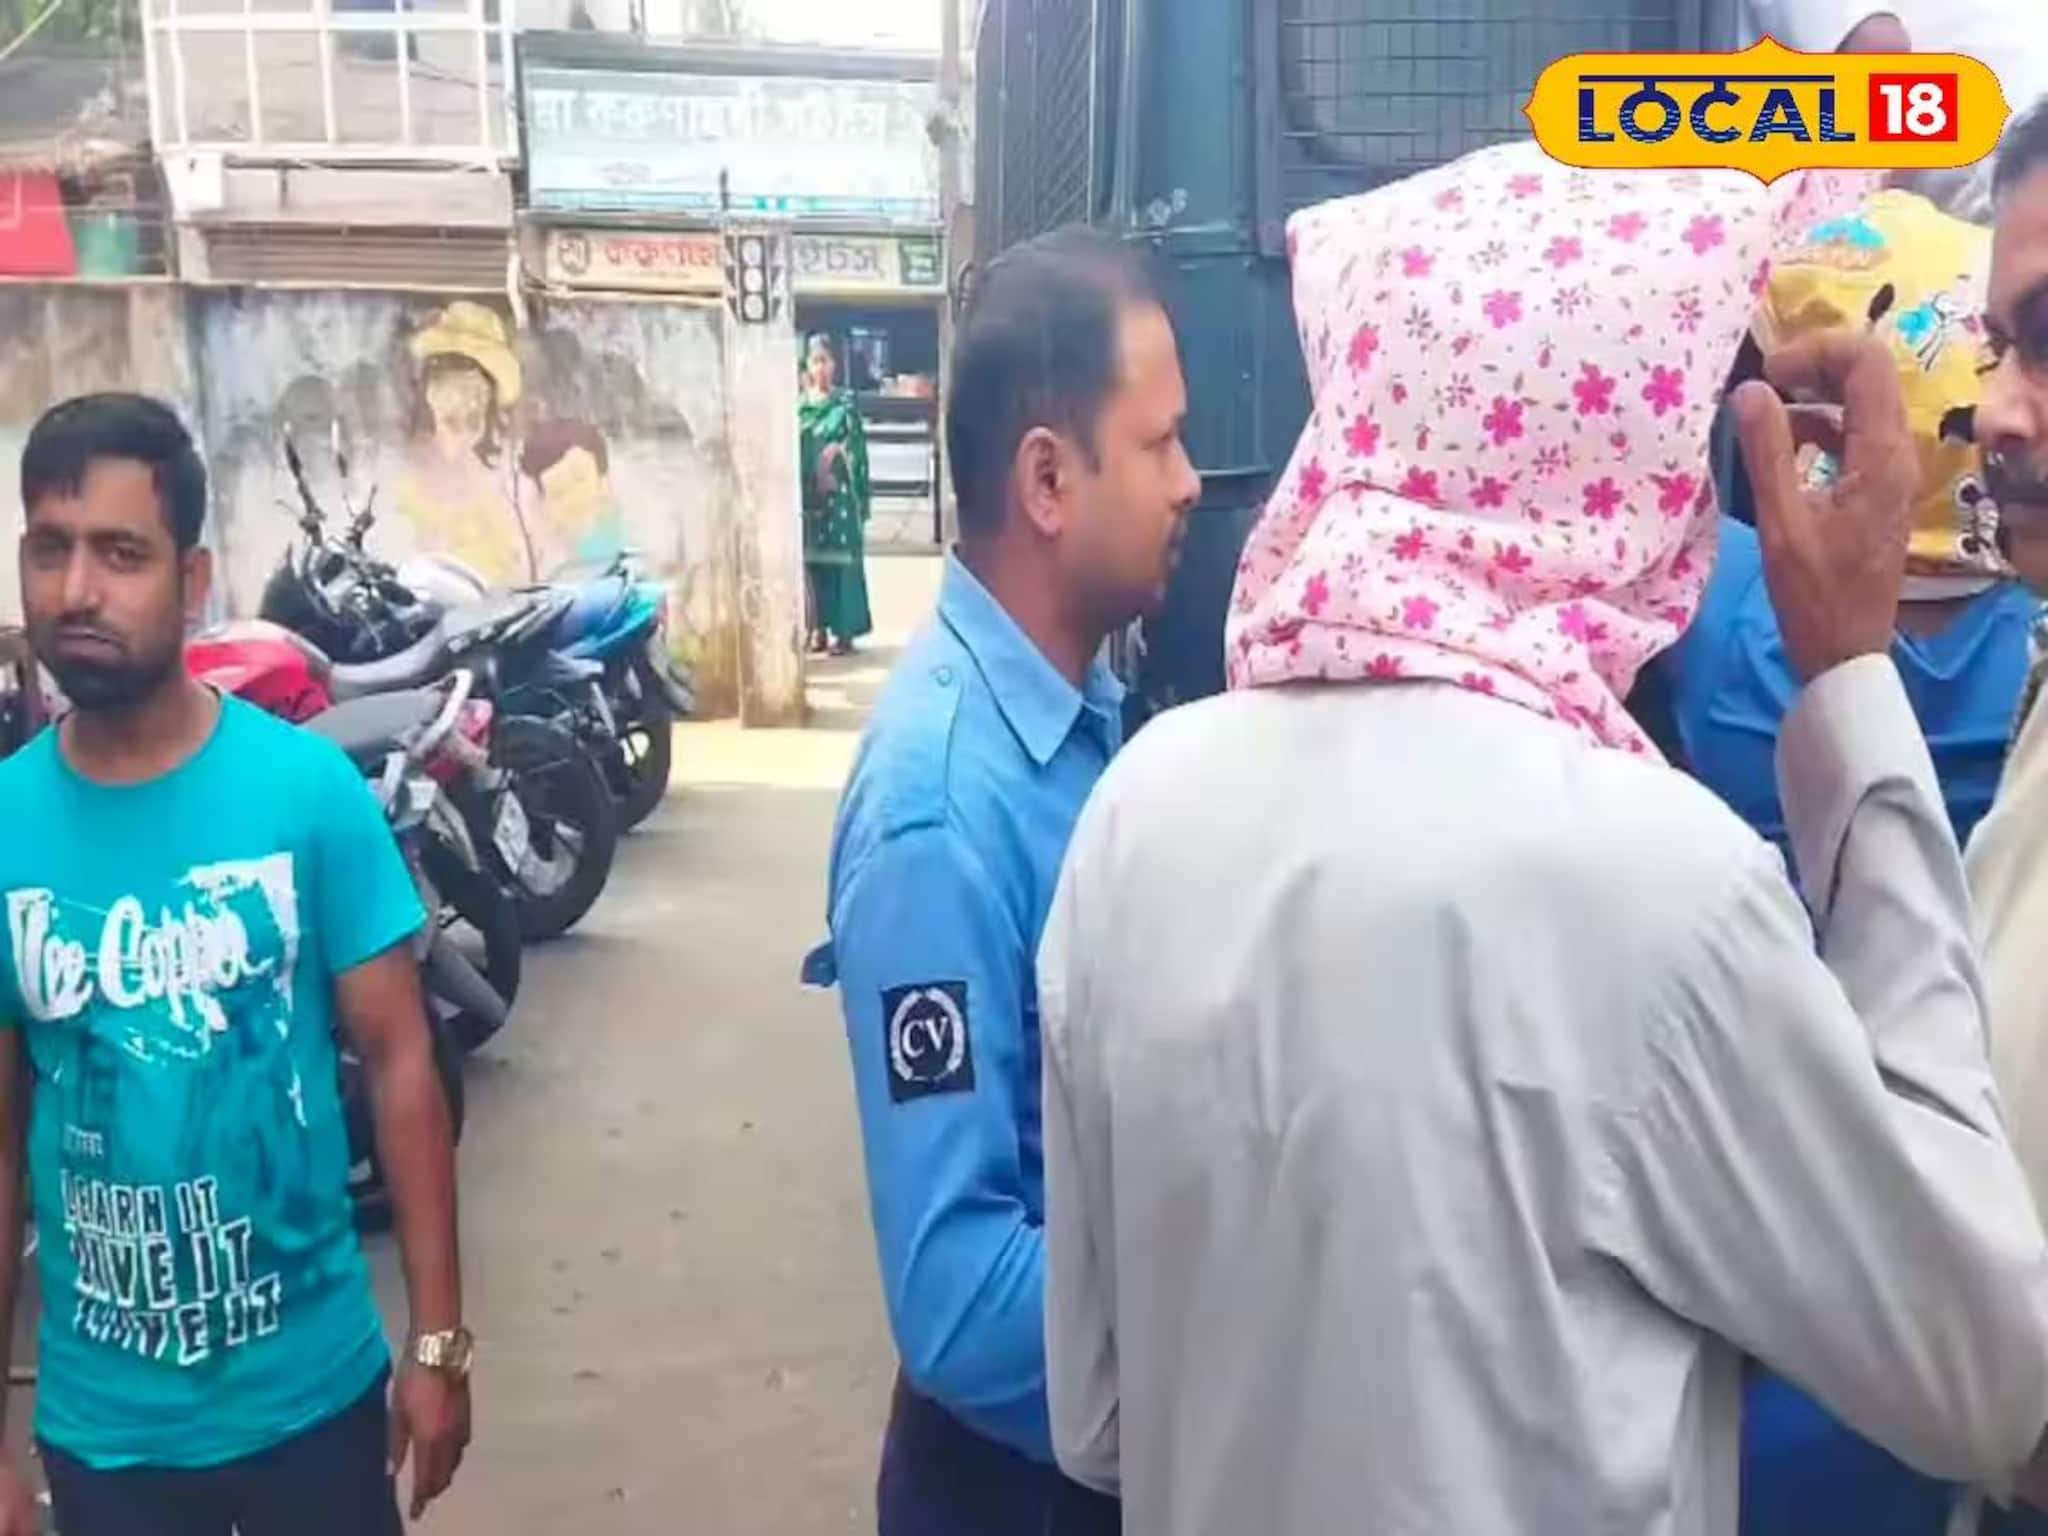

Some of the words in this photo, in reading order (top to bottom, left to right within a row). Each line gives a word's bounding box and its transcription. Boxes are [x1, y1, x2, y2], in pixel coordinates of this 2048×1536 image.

[901, 1016, 949, 1058] CV
[175, 1174, 219, 1234] IT
[191, 1215, 251, 1300] IT
[223, 1272, 281, 1348] IT
